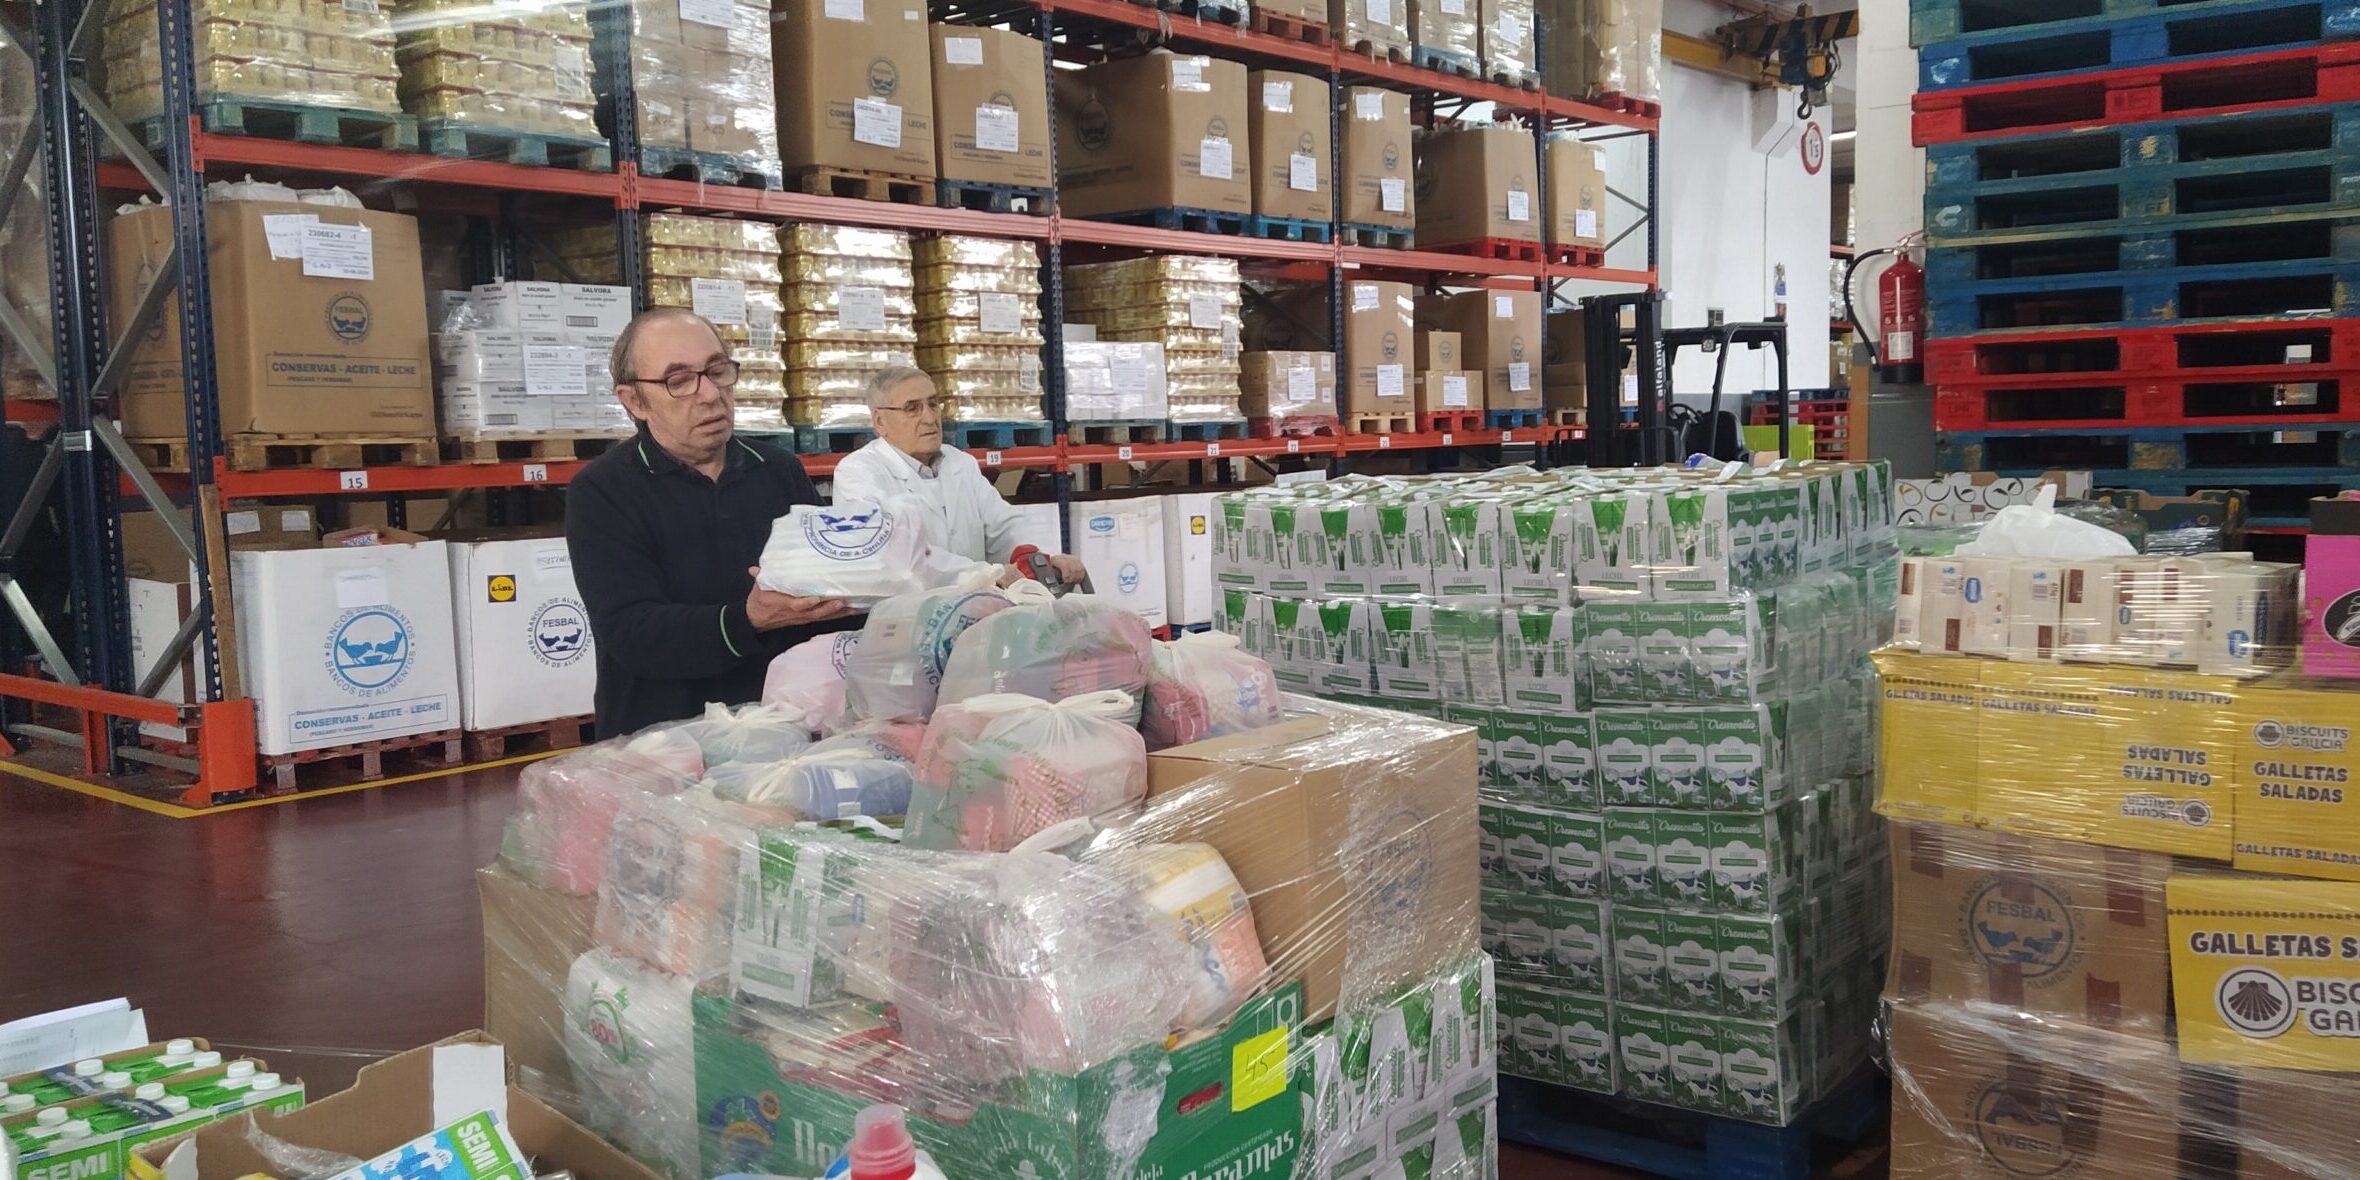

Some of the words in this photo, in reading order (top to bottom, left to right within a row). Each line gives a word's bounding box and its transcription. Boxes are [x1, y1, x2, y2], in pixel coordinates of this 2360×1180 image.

[581, 287, 611, 295] SALVORA
[272, 362, 336, 373] CONSERVAS
[344, 364, 381, 374] ACEITE
[387, 365, 417, 375] LECHE
[1655, 339, 1664, 398] alfaland
[990, 453, 999, 463] 19
[347, 477, 363, 489] 15
[529, 470, 543, 481] 16
[542, 617, 580, 628] FESBAL
[324, 660, 356, 695] BANCOS
[357, 688, 373, 698] DE
[375, 650, 417, 697] ALIMENTOS
[294, 714, 359, 730] CONSERVAS
[367, 707, 402, 721] ACEITE
[410, 702, 442, 714] LECHE
[1981, 699, 2041, 714] GALLETAS
[2286, 724, 2349, 739] BISCUITS
[2291, 736, 2344, 750] GALICIA
[2127, 744, 2207, 766] SALADAS
[2122, 764, 2212, 787] GALLETAS
[2253, 761, 2349, 783] GALLETAS
[2259, 782, 2344, 804] SALADAS
[2236, 843, 2302, 858] GALLETAS
[1985, 900, 2057, 922] FESBAL
[2190, 931, 2332, 958] GALLETAS
[2309, 1008, 2360, 1031] GA
[457, 1121, 502, 1173] SEMI
